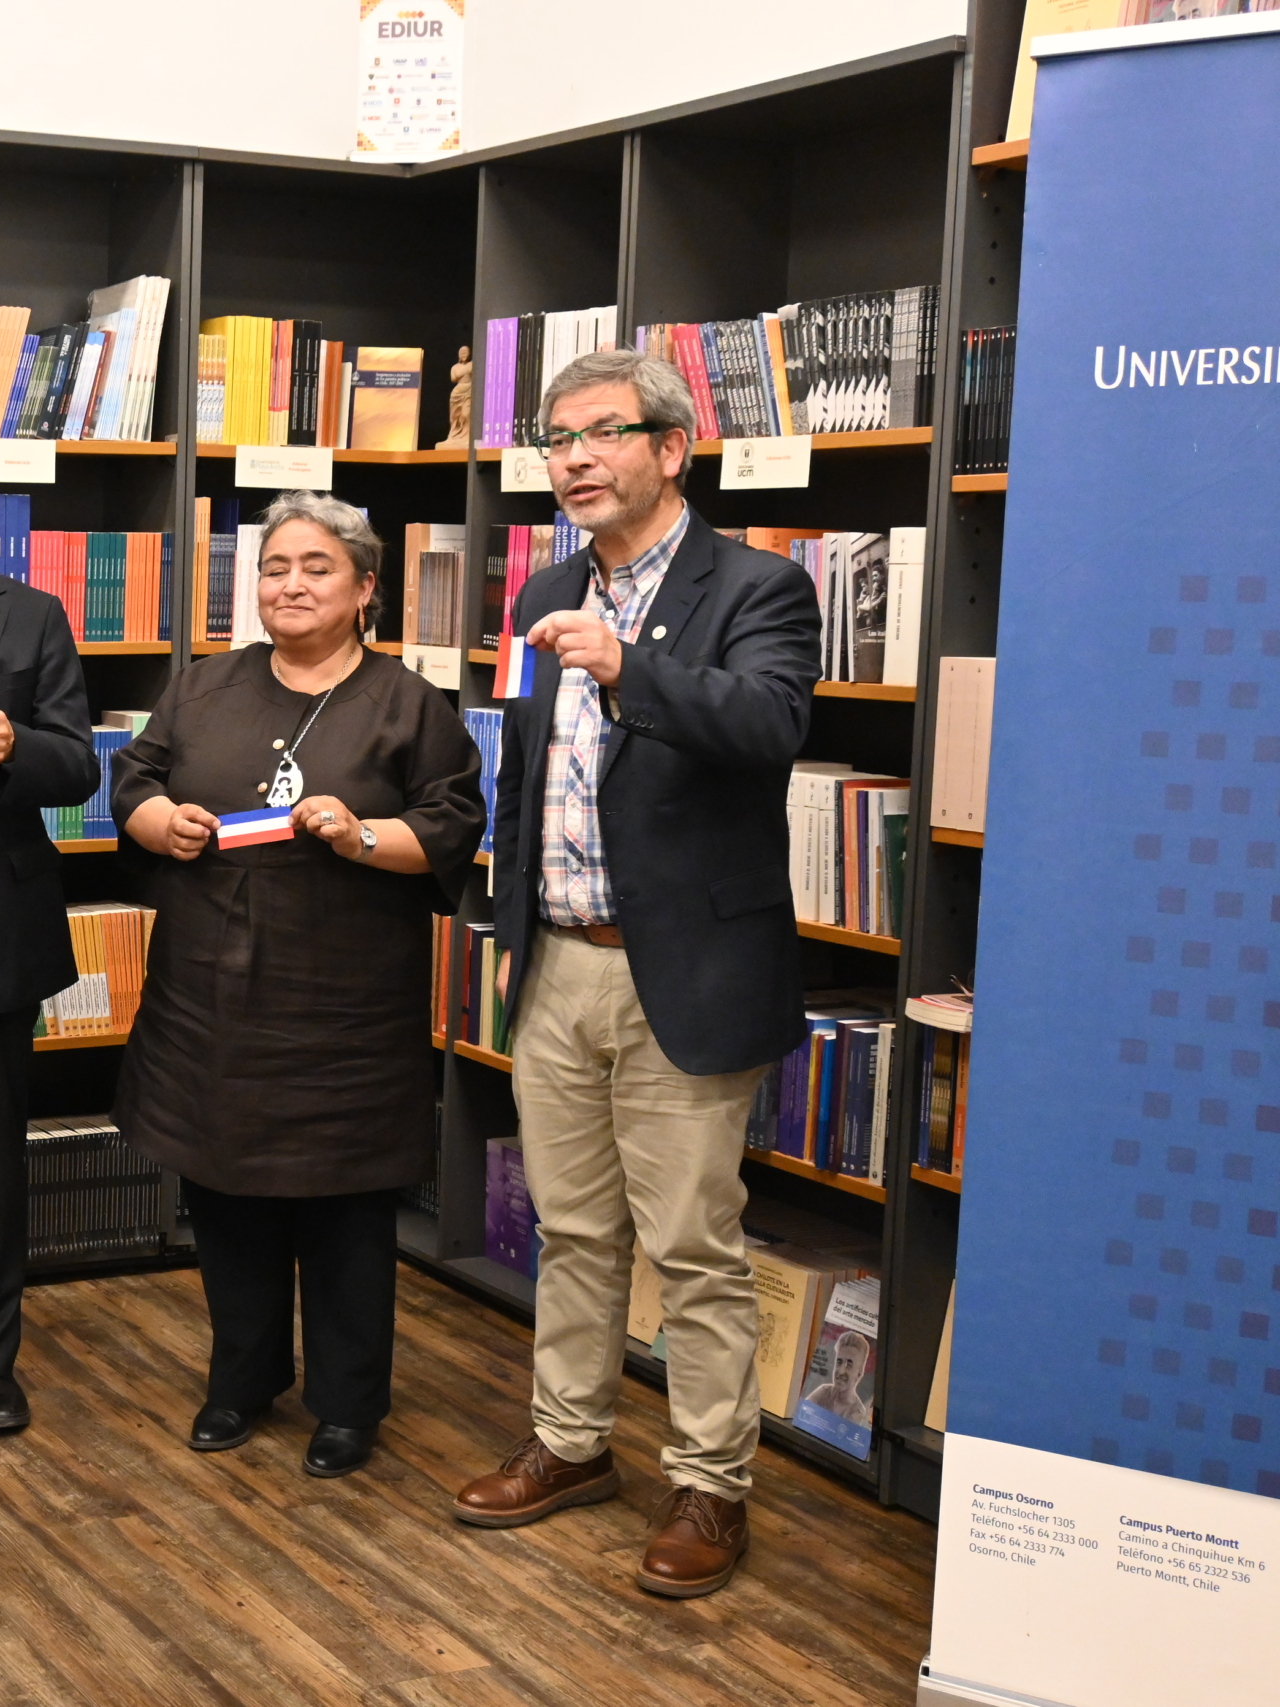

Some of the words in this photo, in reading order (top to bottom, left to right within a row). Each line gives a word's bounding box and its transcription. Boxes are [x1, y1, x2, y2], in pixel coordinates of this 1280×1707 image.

[378, 20, 443, 39] EDIUR
[1094, 345, 1280, 390] UNIVERSI
[833, 1306, 842, 1314] del
[842, 1309, 853, 1319] arte
[853, 1314, 875, 1328] mercado
[835, 1297, 846, 1307] Los
[973, 1484, 1014, 1500] Campus
[1016, 1493, 1054, 1509] Osorno
[971, 1499, 986, 1510] Av.
[989, 1502, 1050, 1523] Fuchslocher
[1053, 1516, 1076, 1529] 1305
[970, 1528, 986, 1540] Fax
[989, 1533, 1006, 1544] +56
[1009, 1537, 1021, 1547] 64
[1023, 1540, 1046, 1553] 2333
[1049, 1545, 1065, 1557] 774
[971, 1513, 1014, 1531] Teléfono
[1018, 1524, 1034, 1535] +56
[1037, 1528, 1050, 1539] 64
[1053, 1531, 1075, 1544] 2333
[1078, 1537, 1098, 1550] 000
[1119, 1515, 1163, 1532] Campus
[1166, 1525, 1203, 1541] Puerto
[1205, 1533, 1239, 1550] Montt
[969, 1542, 1008, 1561] Osorno,
[1011, 1552, 1036, 1566] Chile
[1118, 1530, 1159, 1548] Camino
[1162, 1541, 1168, 1550] a
[1171, 1542, 1234, 1564] Chinquihue
[1237, 1556, 1255, 1568] Km
[1258, 1561, 1266, 1571] 6
[1118, 1545, 1164, 1564] Teléfono
[1167, 1558, 1186, 1569] +56
[1188, 1561, 1201, 1573] 65
[1204, 1565, 1228, 1579] 2322
[1231, 1570, 1251, 1584] 536
[1116, 1561, 1152, 1577] Puerto
[1154, 1569, 1190, 1587] Montt,
[1192, 1577, 1221, 1593] Chile
